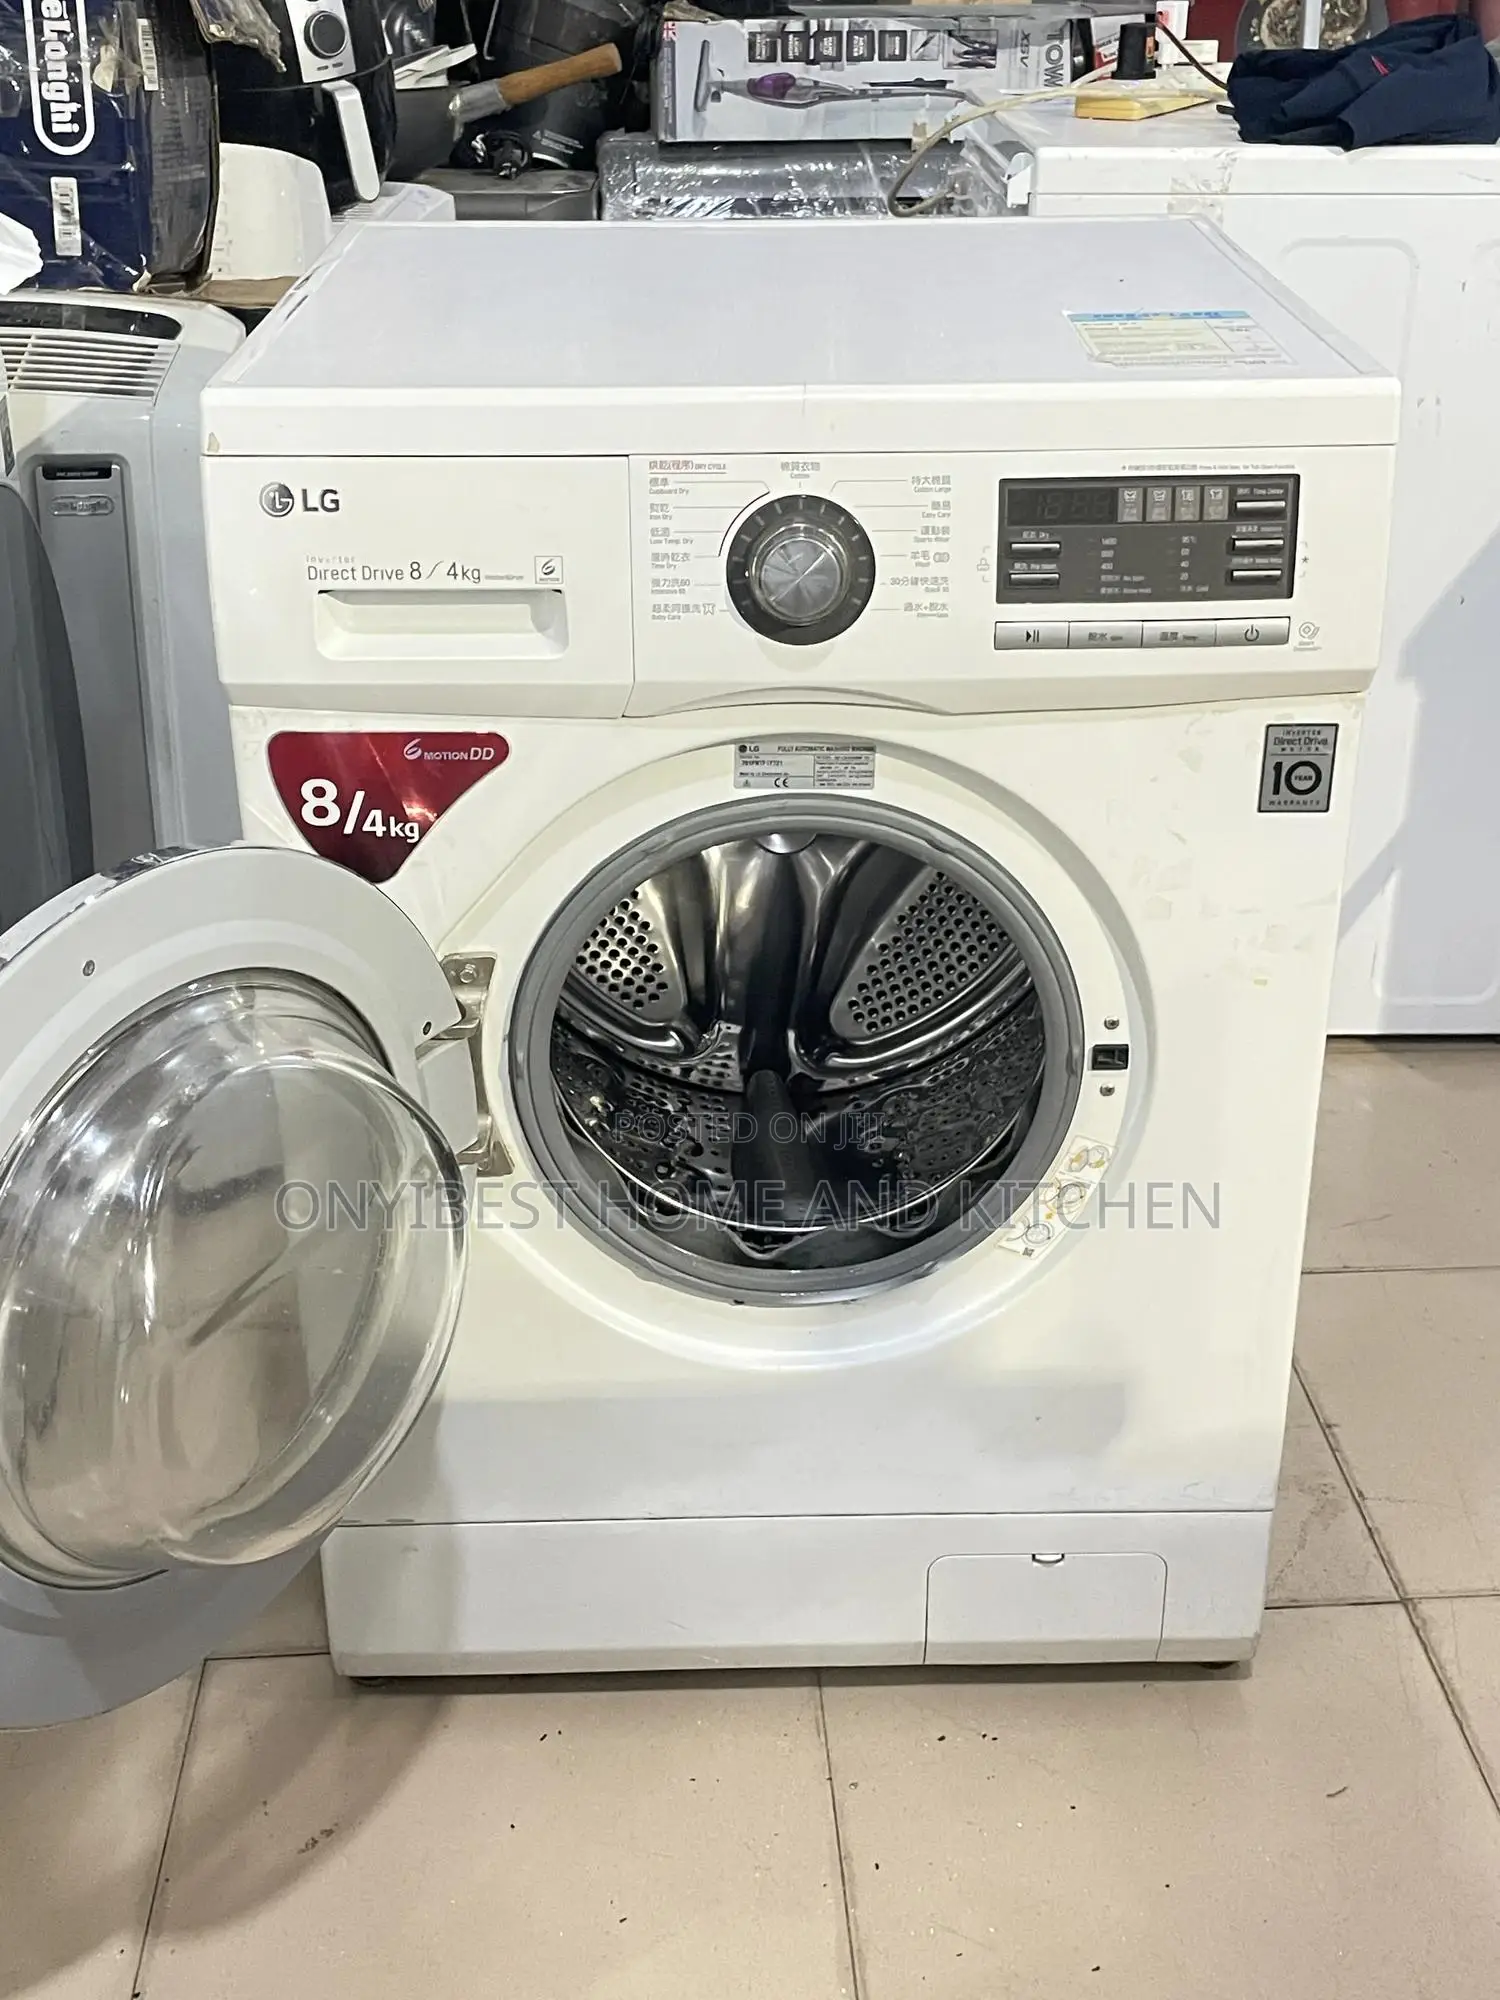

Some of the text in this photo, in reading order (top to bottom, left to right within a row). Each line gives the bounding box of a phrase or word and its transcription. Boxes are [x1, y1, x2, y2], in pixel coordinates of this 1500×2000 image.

[302, 488, 340, 513] LG
[307, 564, 357, 581] Direct
[361, 564, 405, 581] Drive
[1273, 736, 1328, 746] Direct Drive
[1272, 760, 1323, 796] 10
